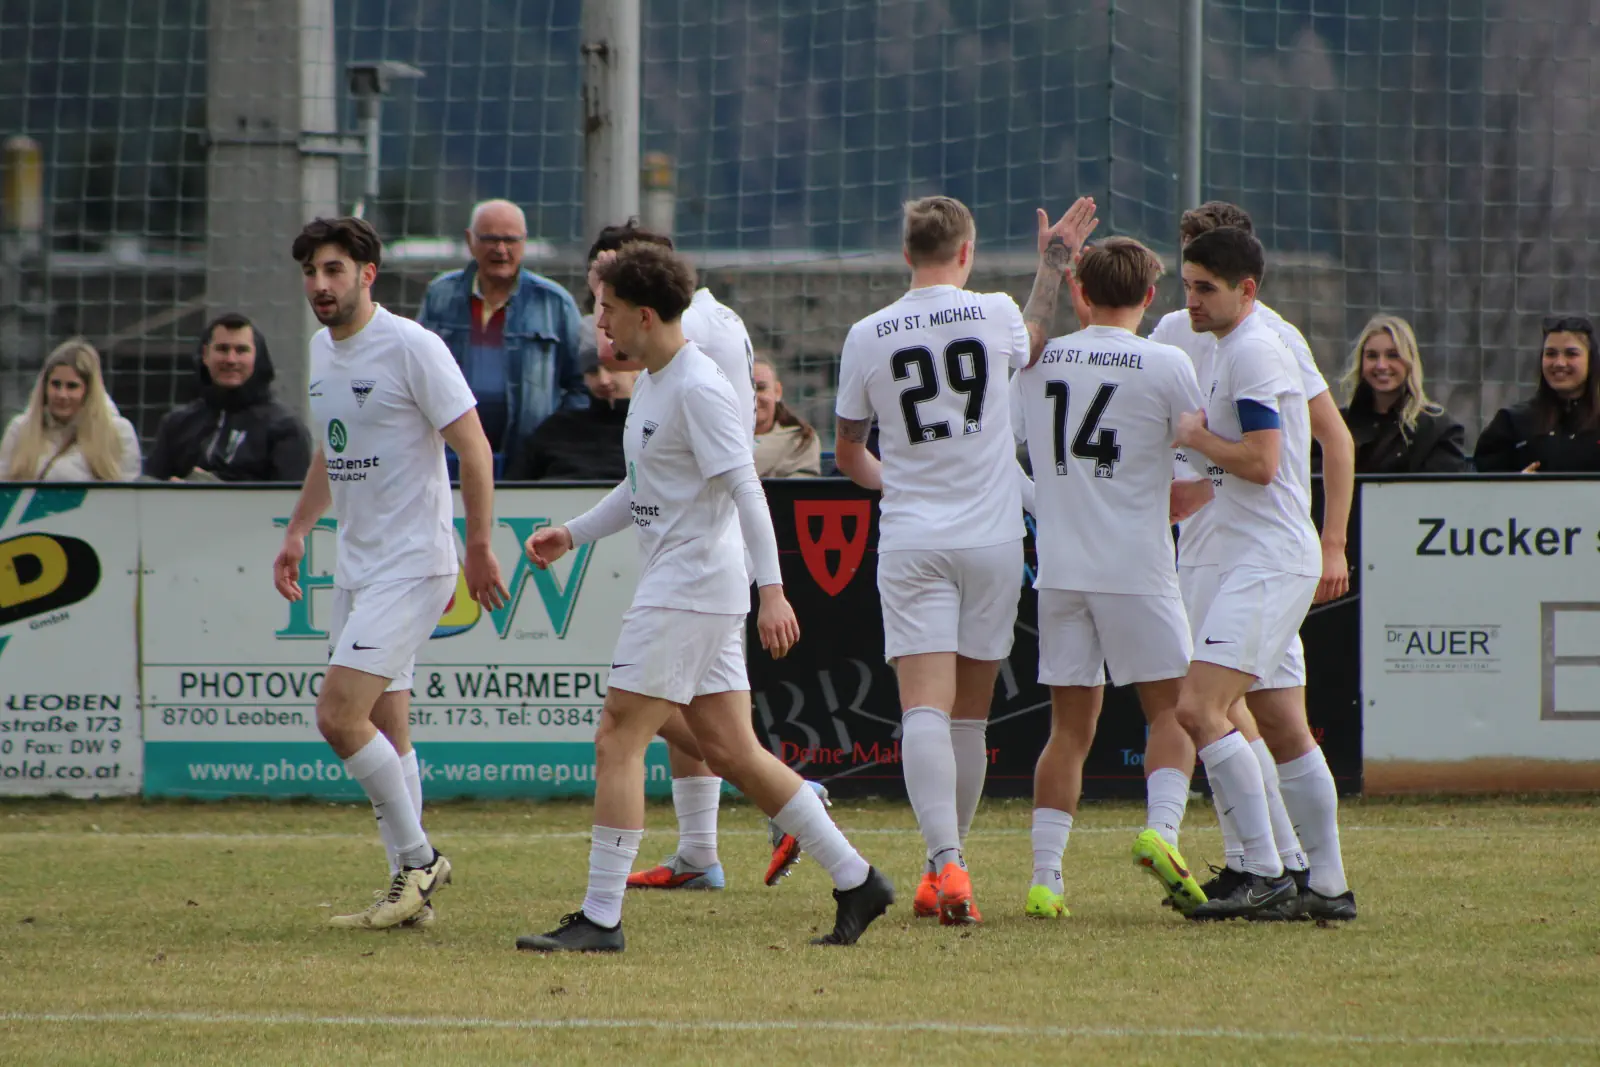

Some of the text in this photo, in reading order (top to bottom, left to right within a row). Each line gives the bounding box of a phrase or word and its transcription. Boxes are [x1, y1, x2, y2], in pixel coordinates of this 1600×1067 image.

[876, 306, 986, 338] ESV ST. MICHAEL
[1042, 350, 1144, 370] ESV ST. MICHAEL
[890, 337, 989, 445] 29
[1045, 380, 1122, 479] 14
[1416, 518, 1582, 556] Zucker
[1387, 630, 1405, 643] Dr.
[427, 672, 446, 698] &
[455, 664, 608, 699] WÄRMEPU
[86, 716, 122, 732] 173
[162, 707, 219, 725] 8700
[225, 707, 309, 728] Leoben,
[408, 709, 437, 726] str.
[445, 708, 489, 728] 173,
[496, 707, 531, 726] Tel:
[25, 739, 63, 754] Fax:
[71, 739, 105, 754] DW
[110, 739, 122, 754] 9
[780, 741, 844, 764] Deine
[0, 760, 120, 779] old.co.at
